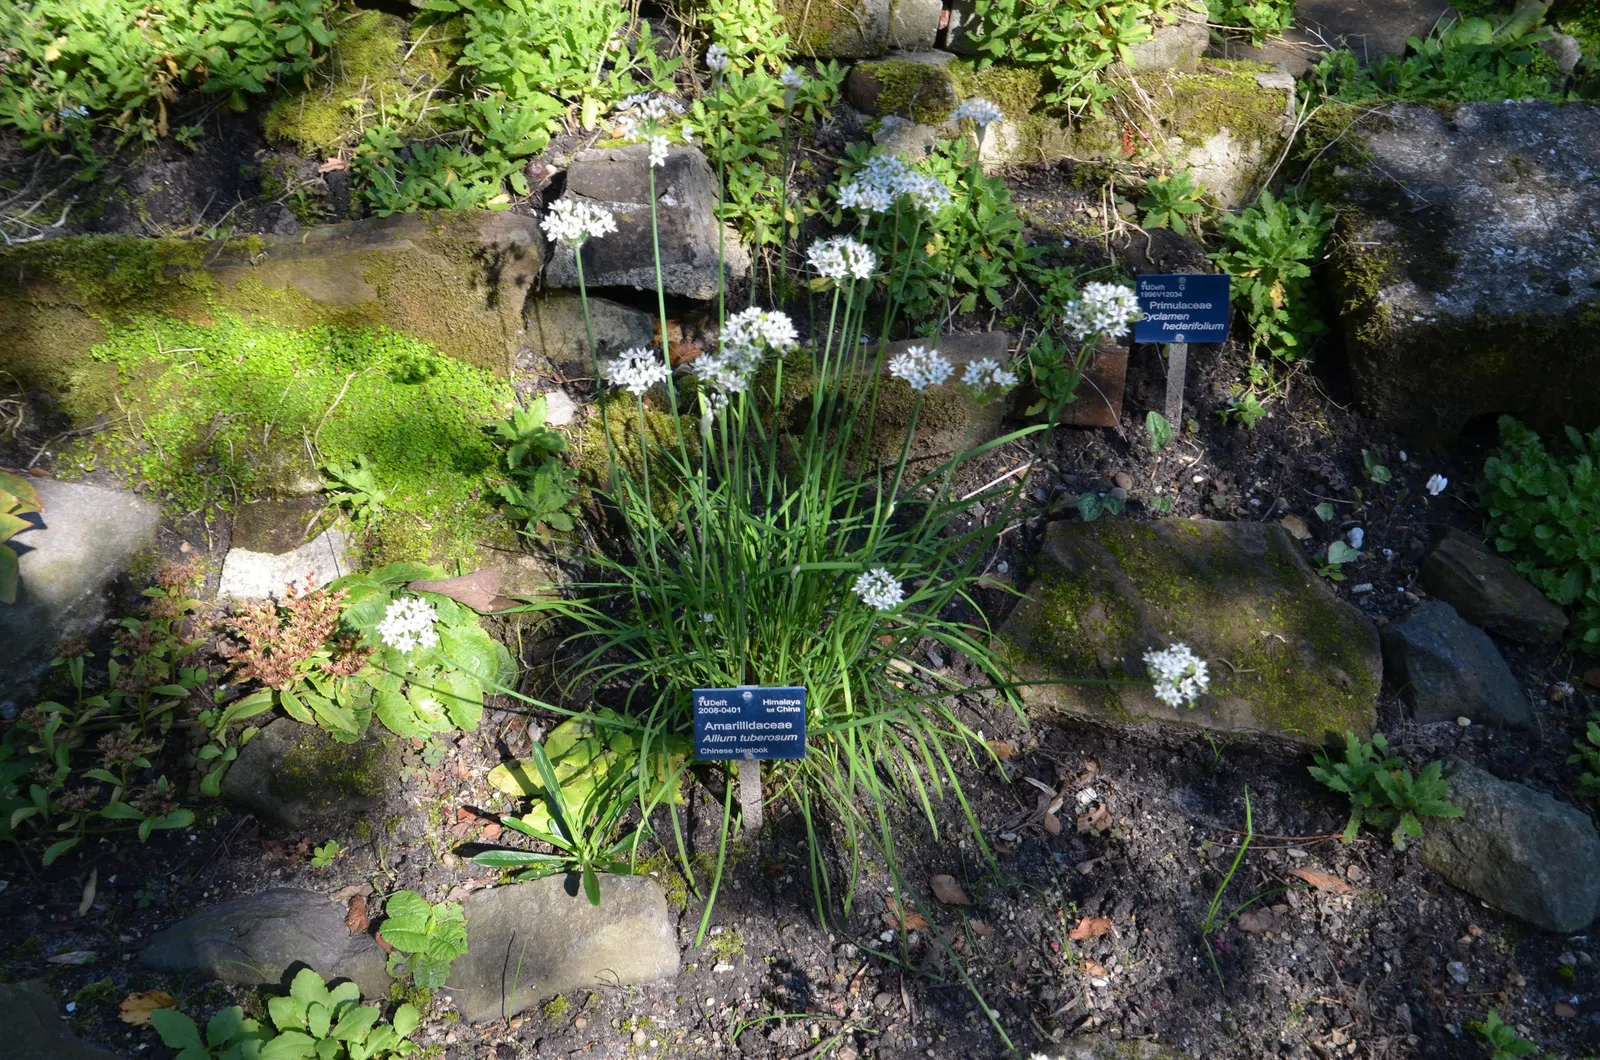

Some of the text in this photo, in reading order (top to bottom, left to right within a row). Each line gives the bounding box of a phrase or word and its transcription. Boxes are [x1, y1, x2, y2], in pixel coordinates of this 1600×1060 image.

[1149, 301, 1212, 309] Primulaceae
[1143, 312, 1189, 322] Cyclamen
[1163, 322, 1224, 330] hederifolium
[698, 706, 741, 714] 2008-0401
[704, 721, 793, 730] Amarillidaceae
[703, 734, 798, 743] Allium tuberosum
